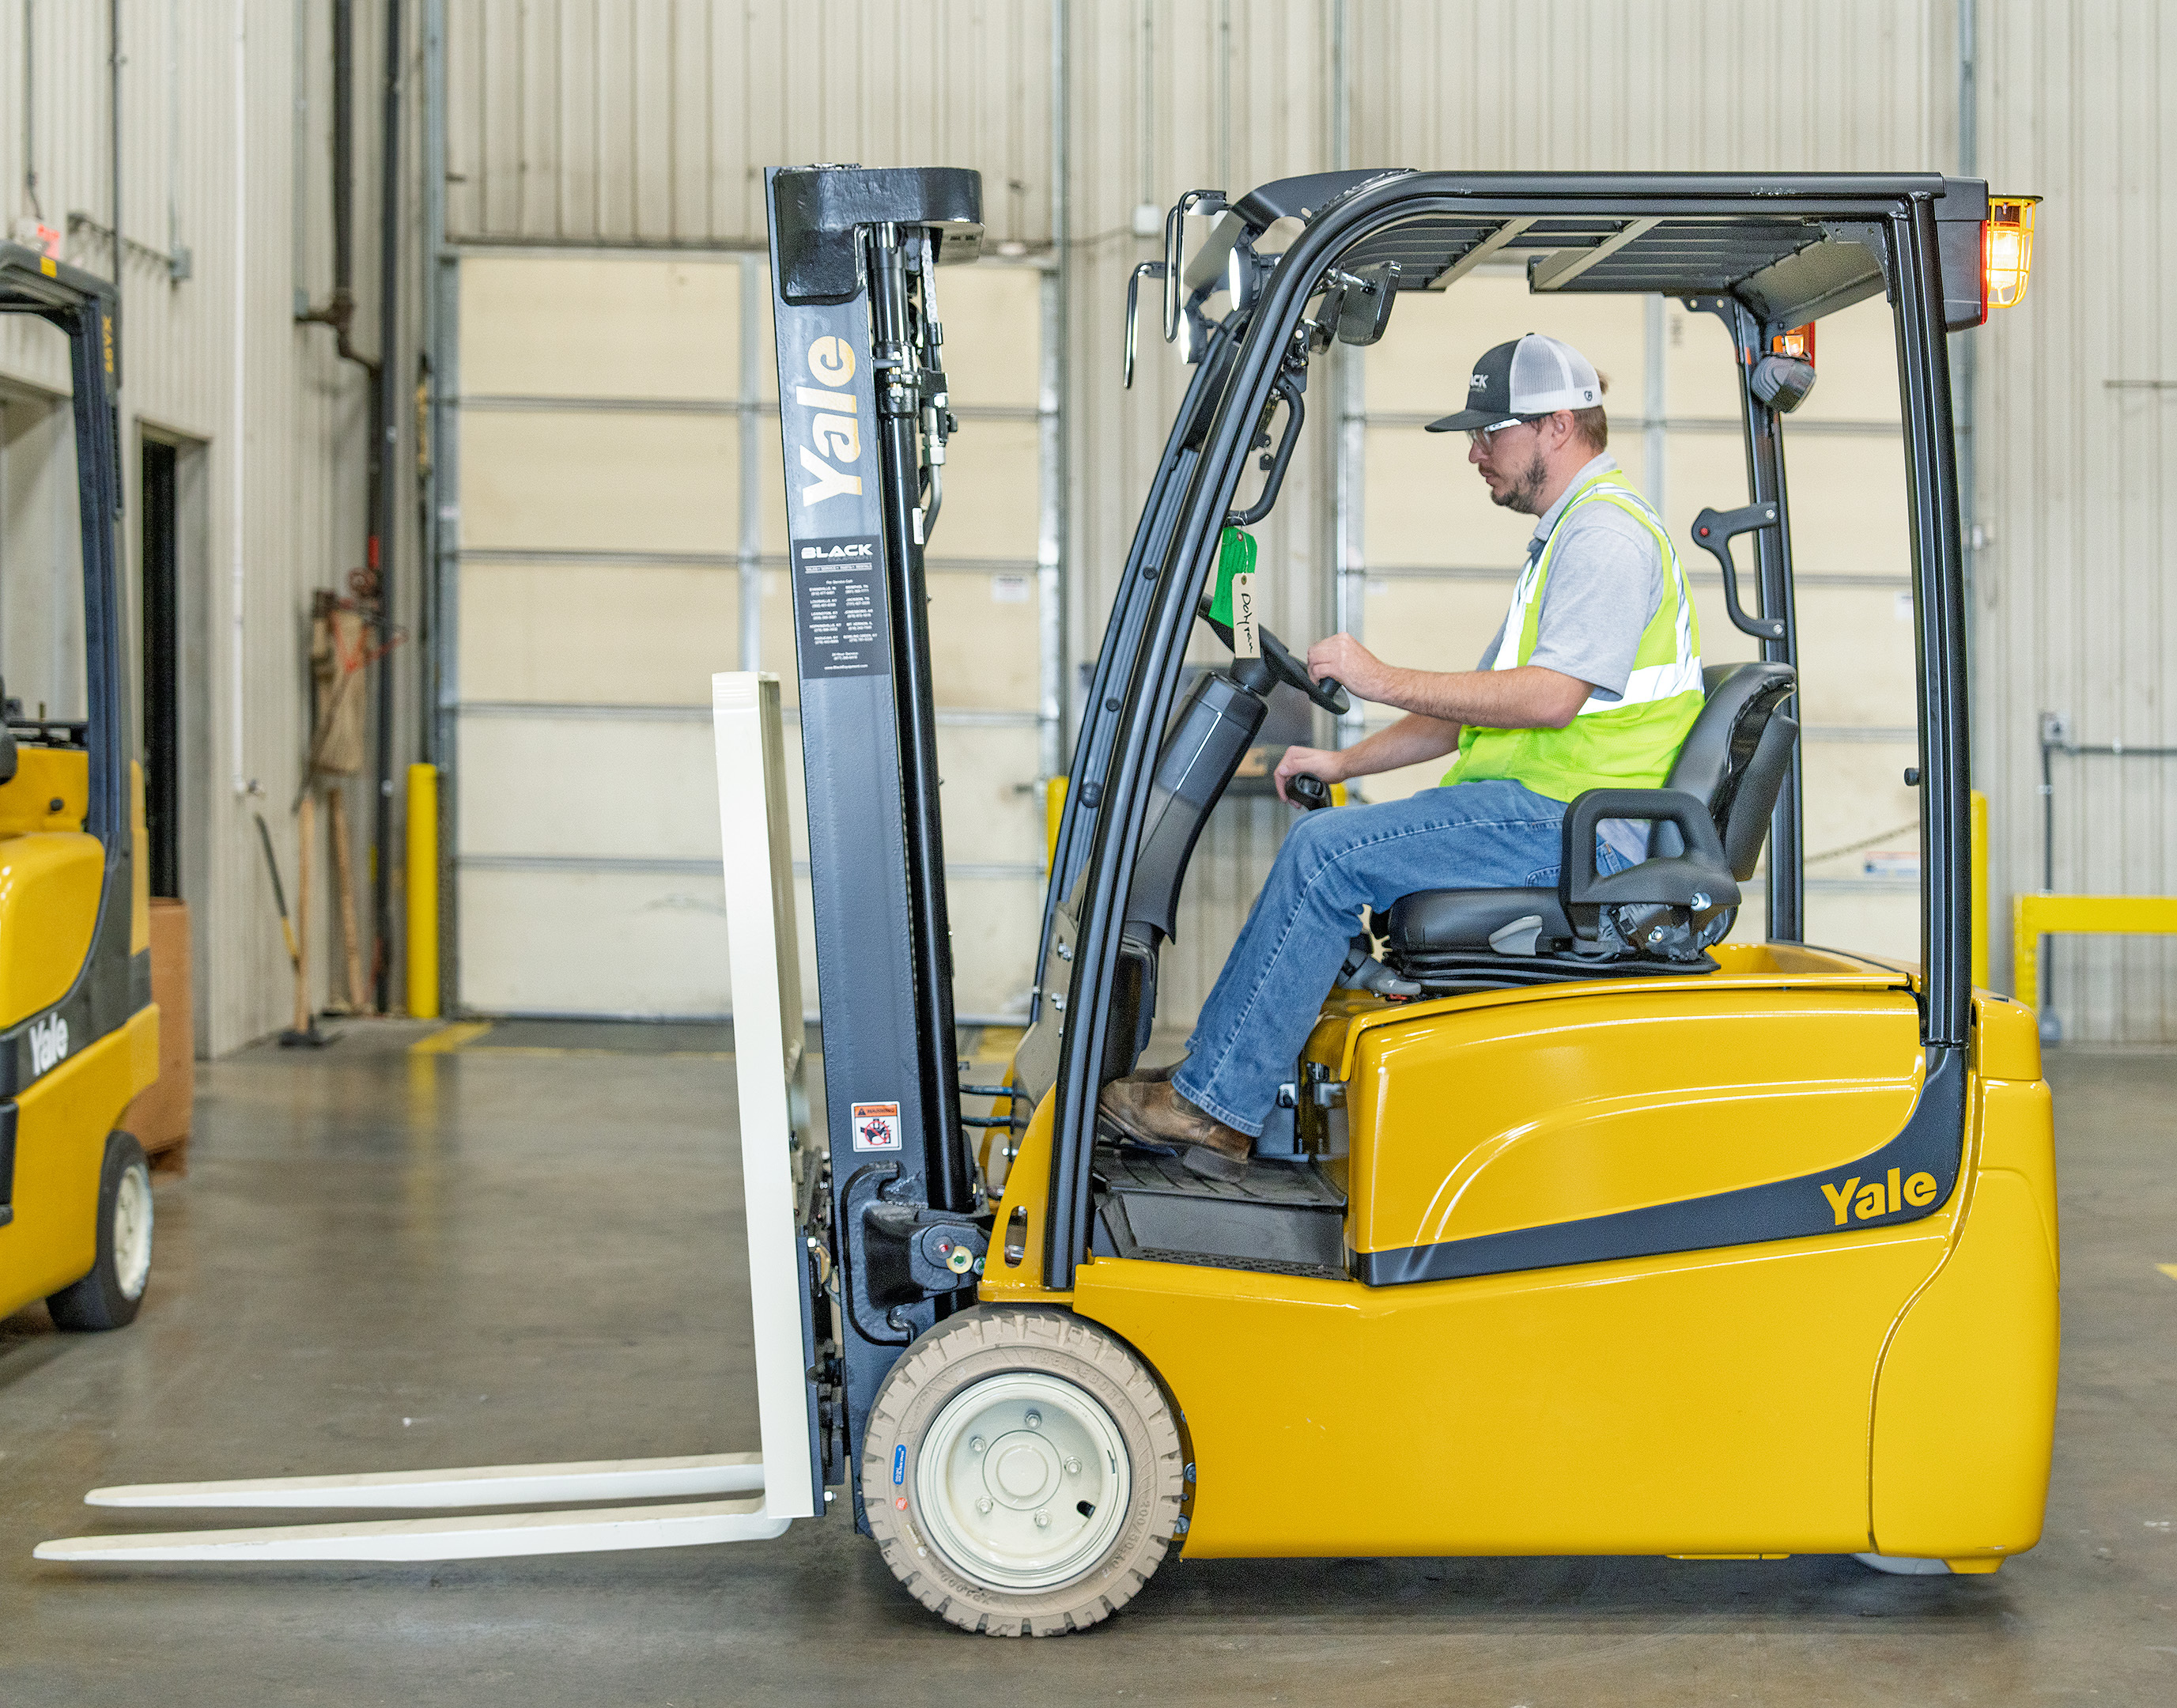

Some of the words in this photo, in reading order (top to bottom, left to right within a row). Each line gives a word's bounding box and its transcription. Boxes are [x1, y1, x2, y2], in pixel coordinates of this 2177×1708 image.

[796, 335, 863, 508] Yale
[801, 543, 873, 559] BLACK
[29, 1011, 69, 1076] Yale
[1820, 1167, 1937, 1226] Yale
